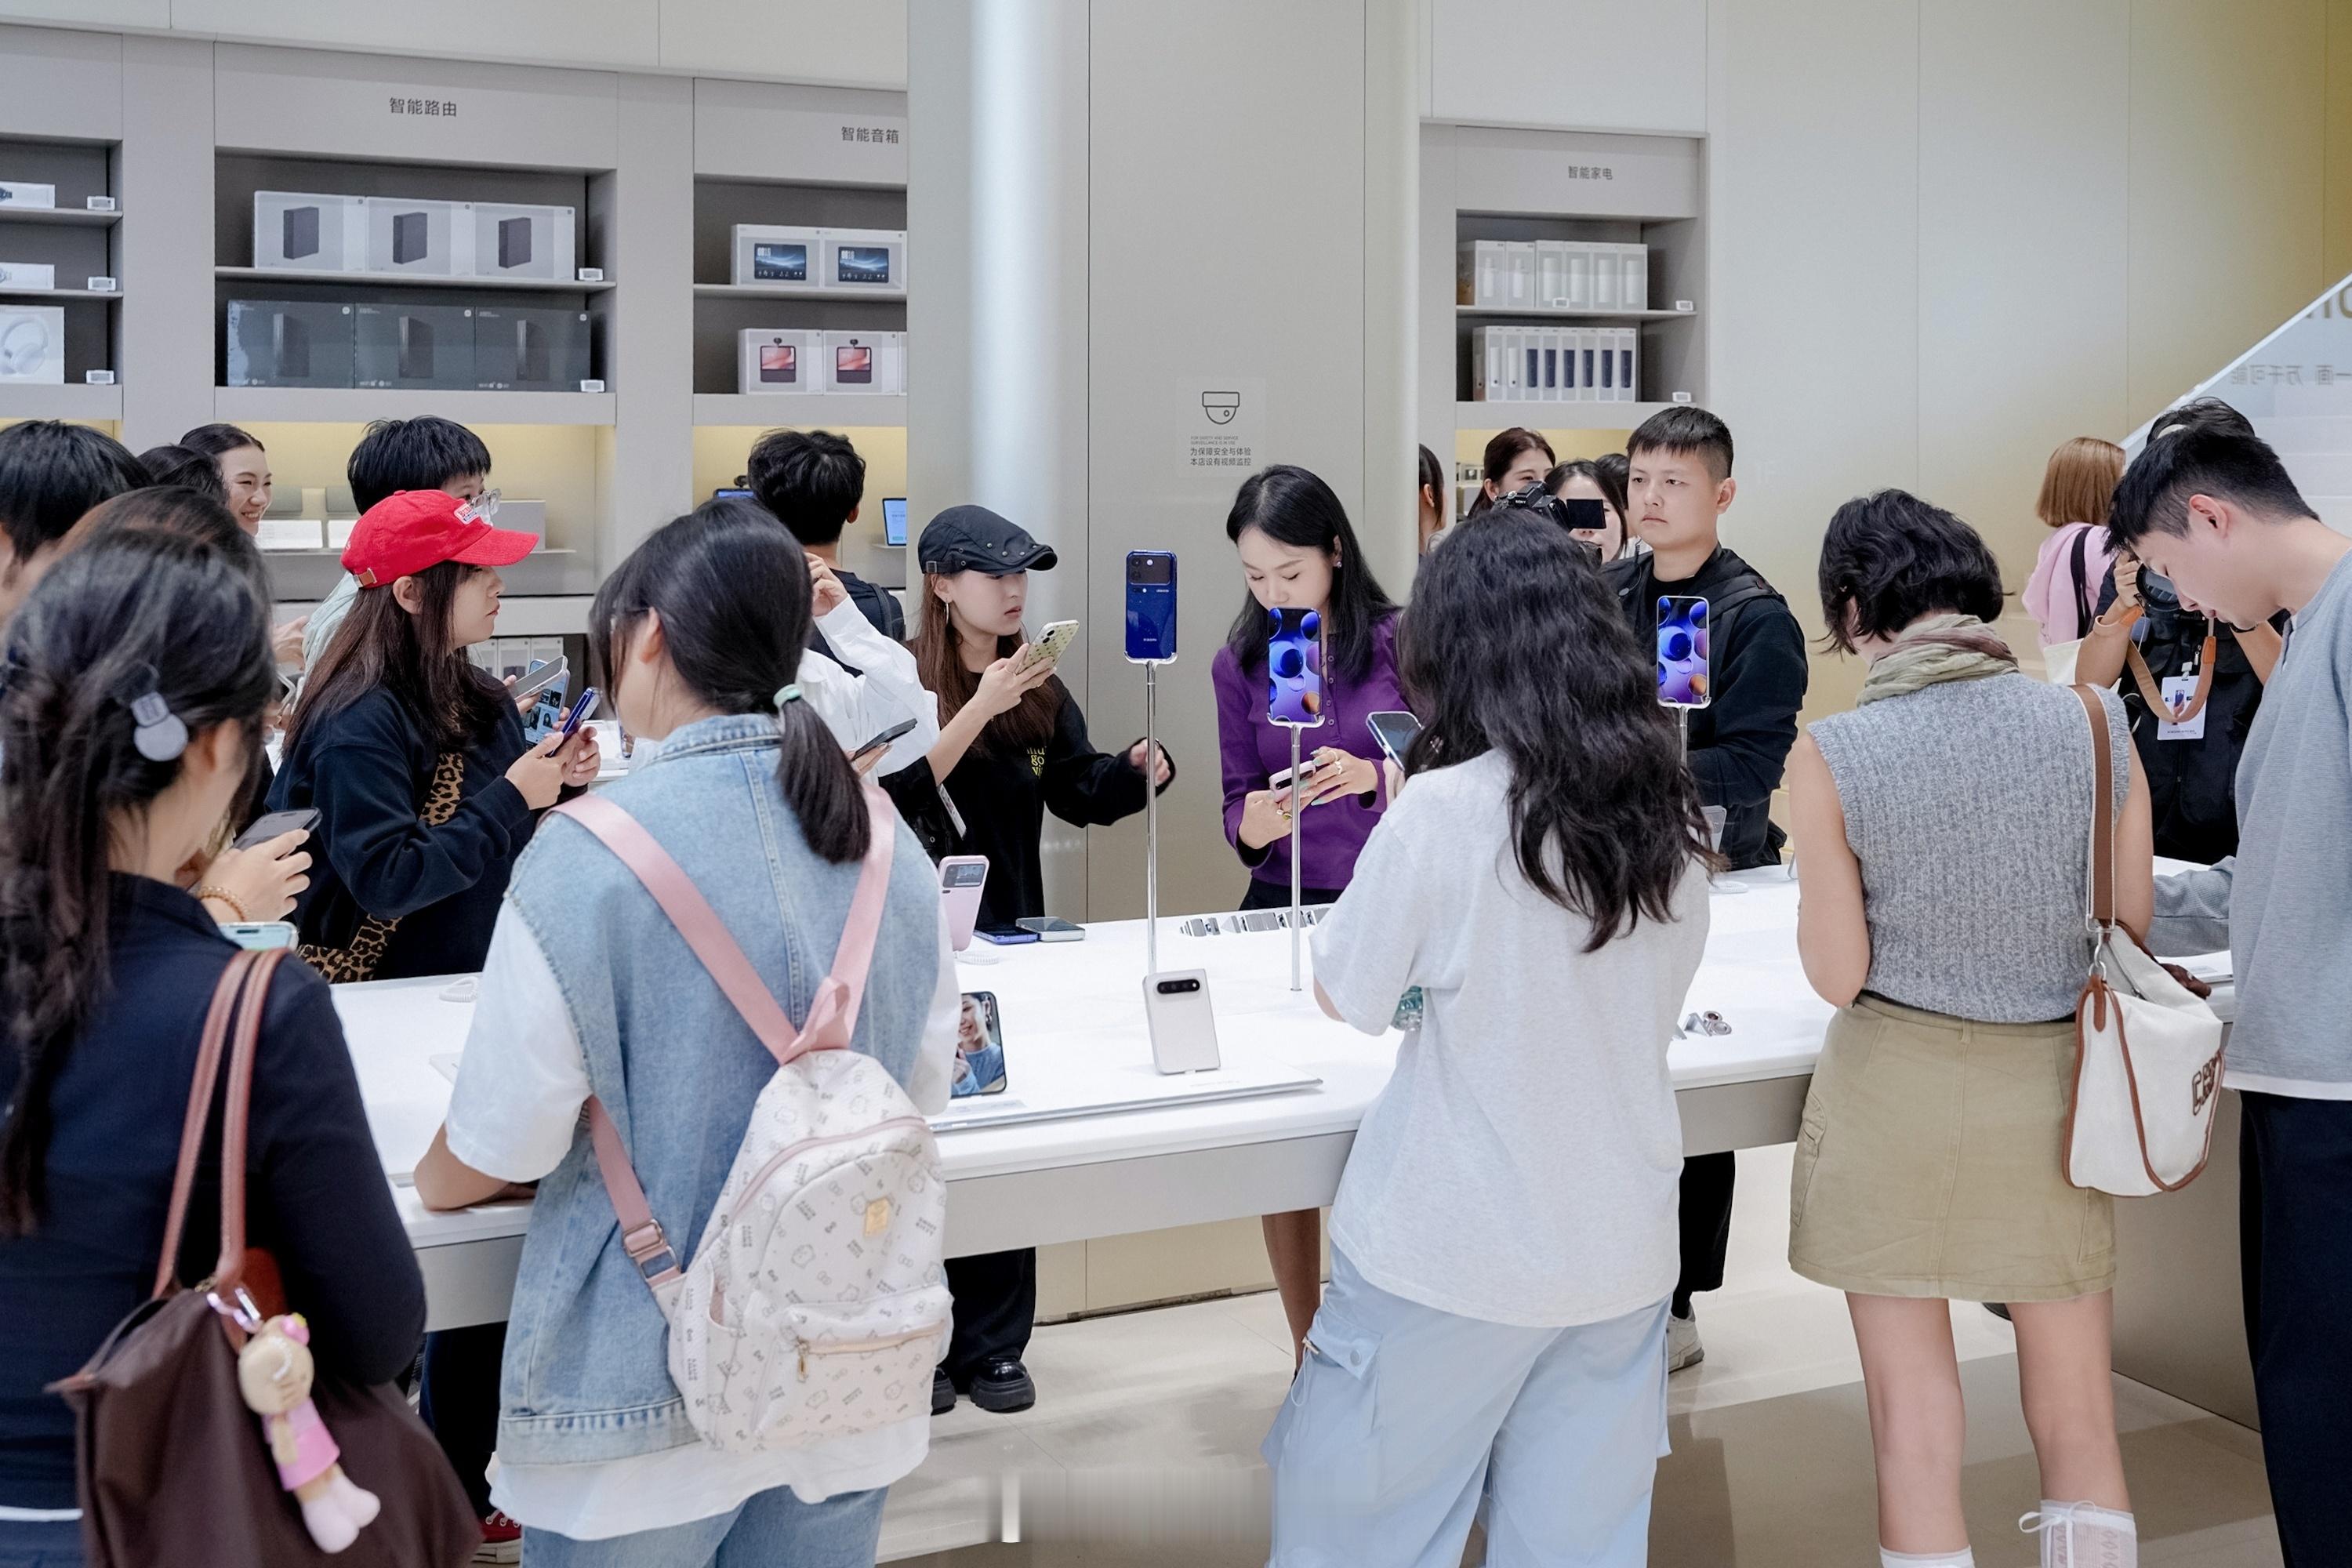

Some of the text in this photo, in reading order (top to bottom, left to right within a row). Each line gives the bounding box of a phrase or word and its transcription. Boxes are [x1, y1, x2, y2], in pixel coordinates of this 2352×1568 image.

[389, 97, 457, 117] 智能路由
[841, 126, 900, 144] 智能音箱
[1568, 165, 1613, 180] 智能家电
[1190, 447, 1251, 456] 为保障安全与体验
